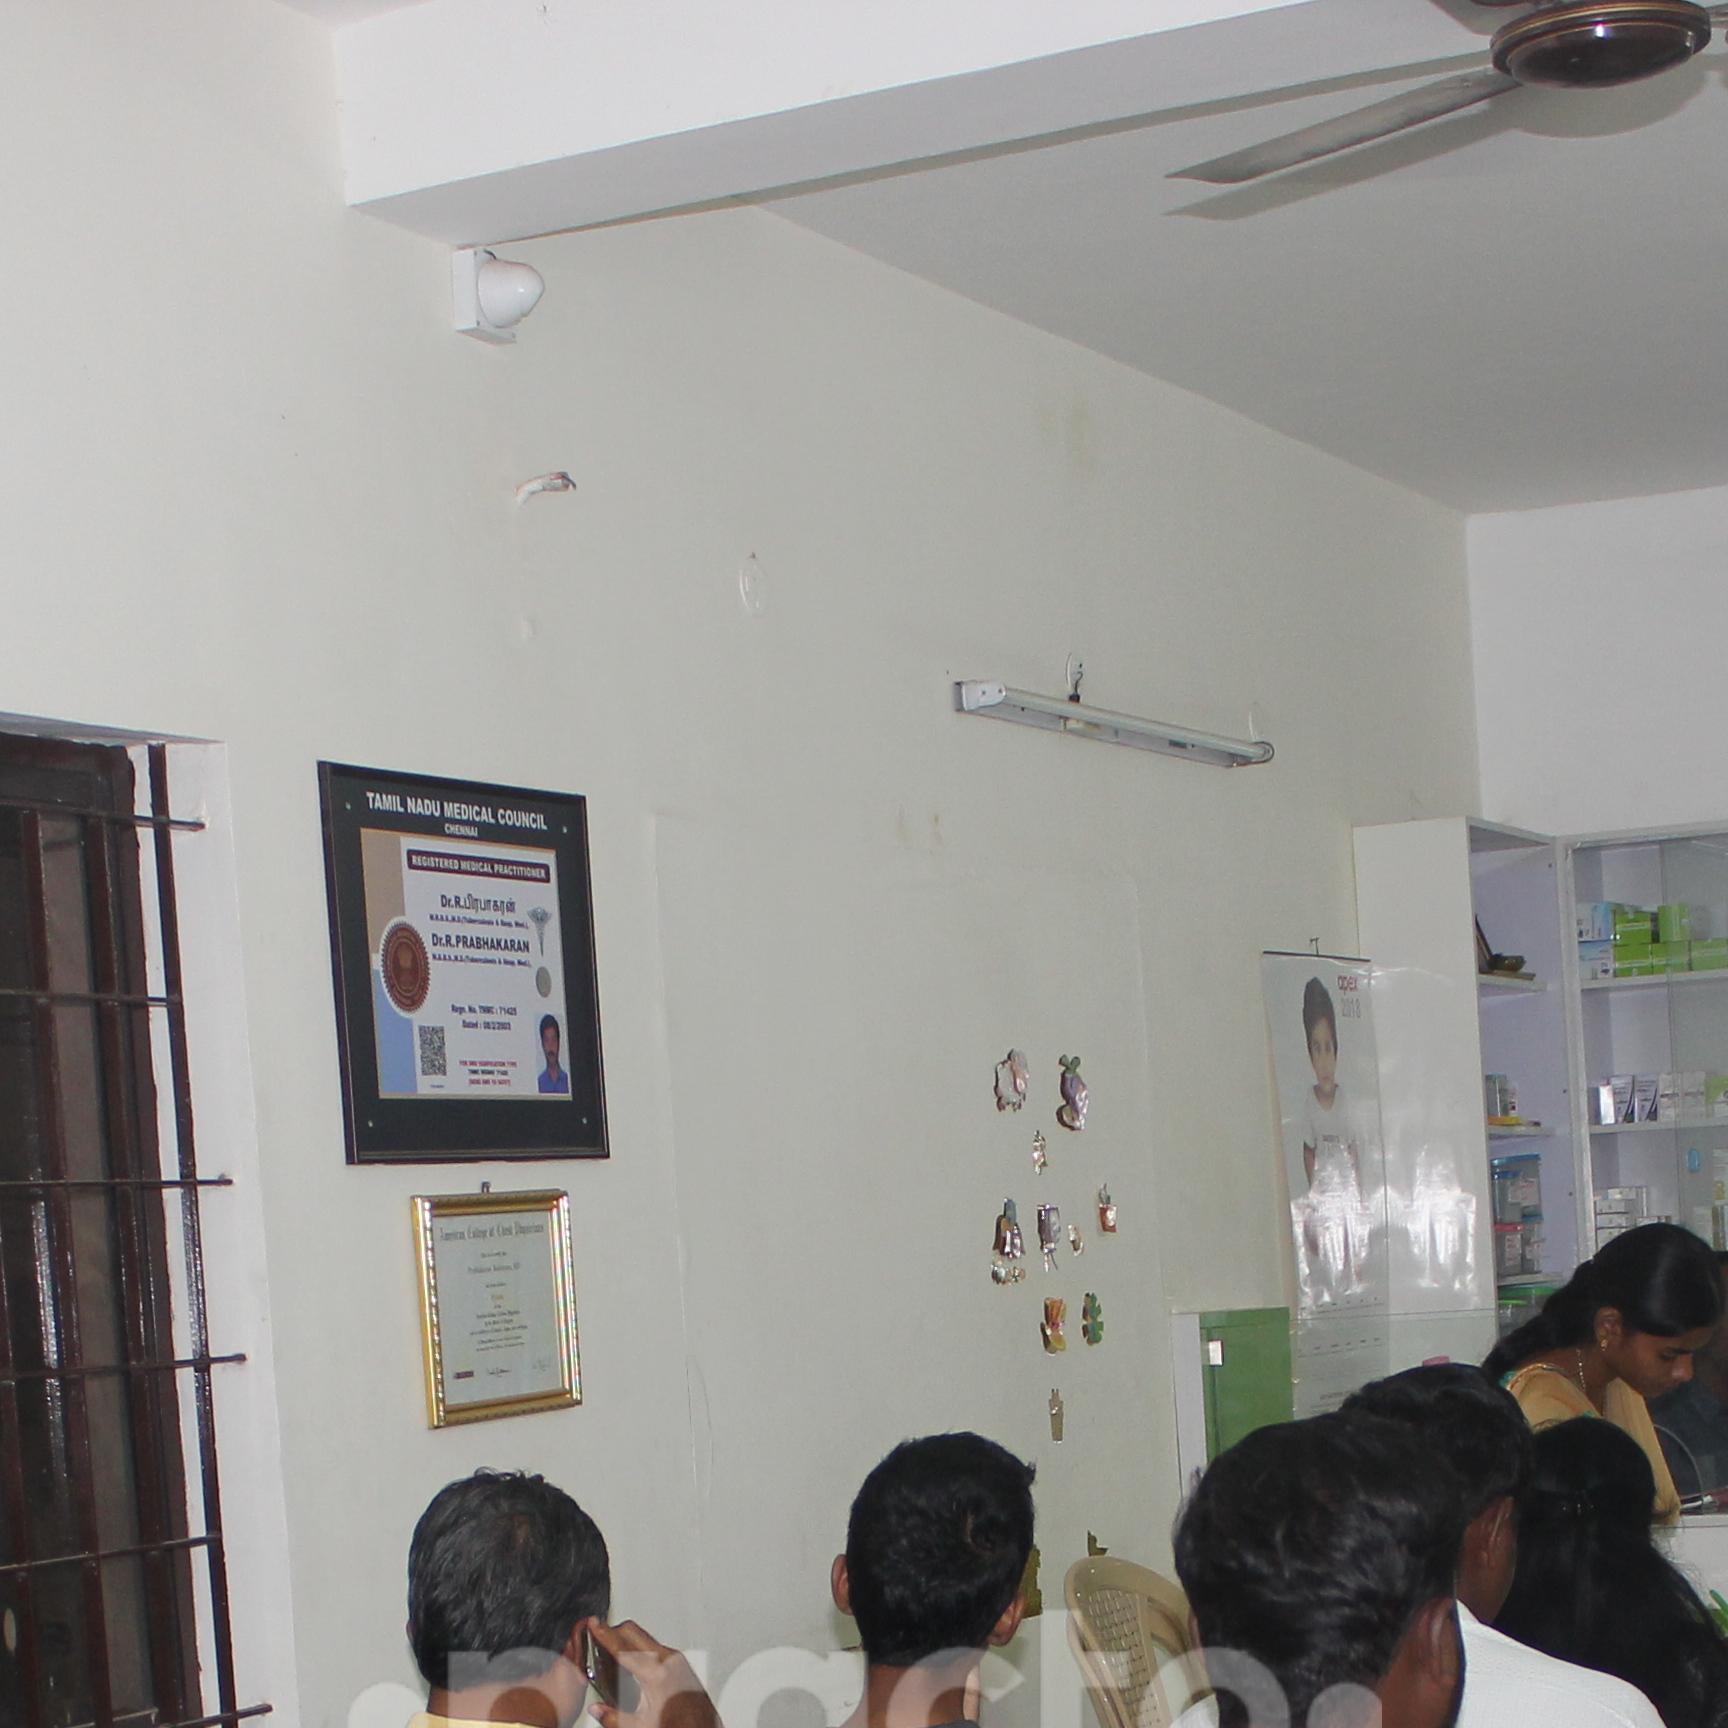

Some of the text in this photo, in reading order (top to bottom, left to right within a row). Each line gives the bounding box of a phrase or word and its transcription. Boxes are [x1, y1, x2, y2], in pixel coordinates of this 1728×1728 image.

[366, 791, 548, 831] TAMIL NADU MEDICAL COUNCIL
[444, 823, 479, 838] CHENNAI
[411, 854, 547, 879] REGISTERED MEDICAL PRACTITIONER
[431, 932, 530, 954] Dr.R.PRABHAKARAN
